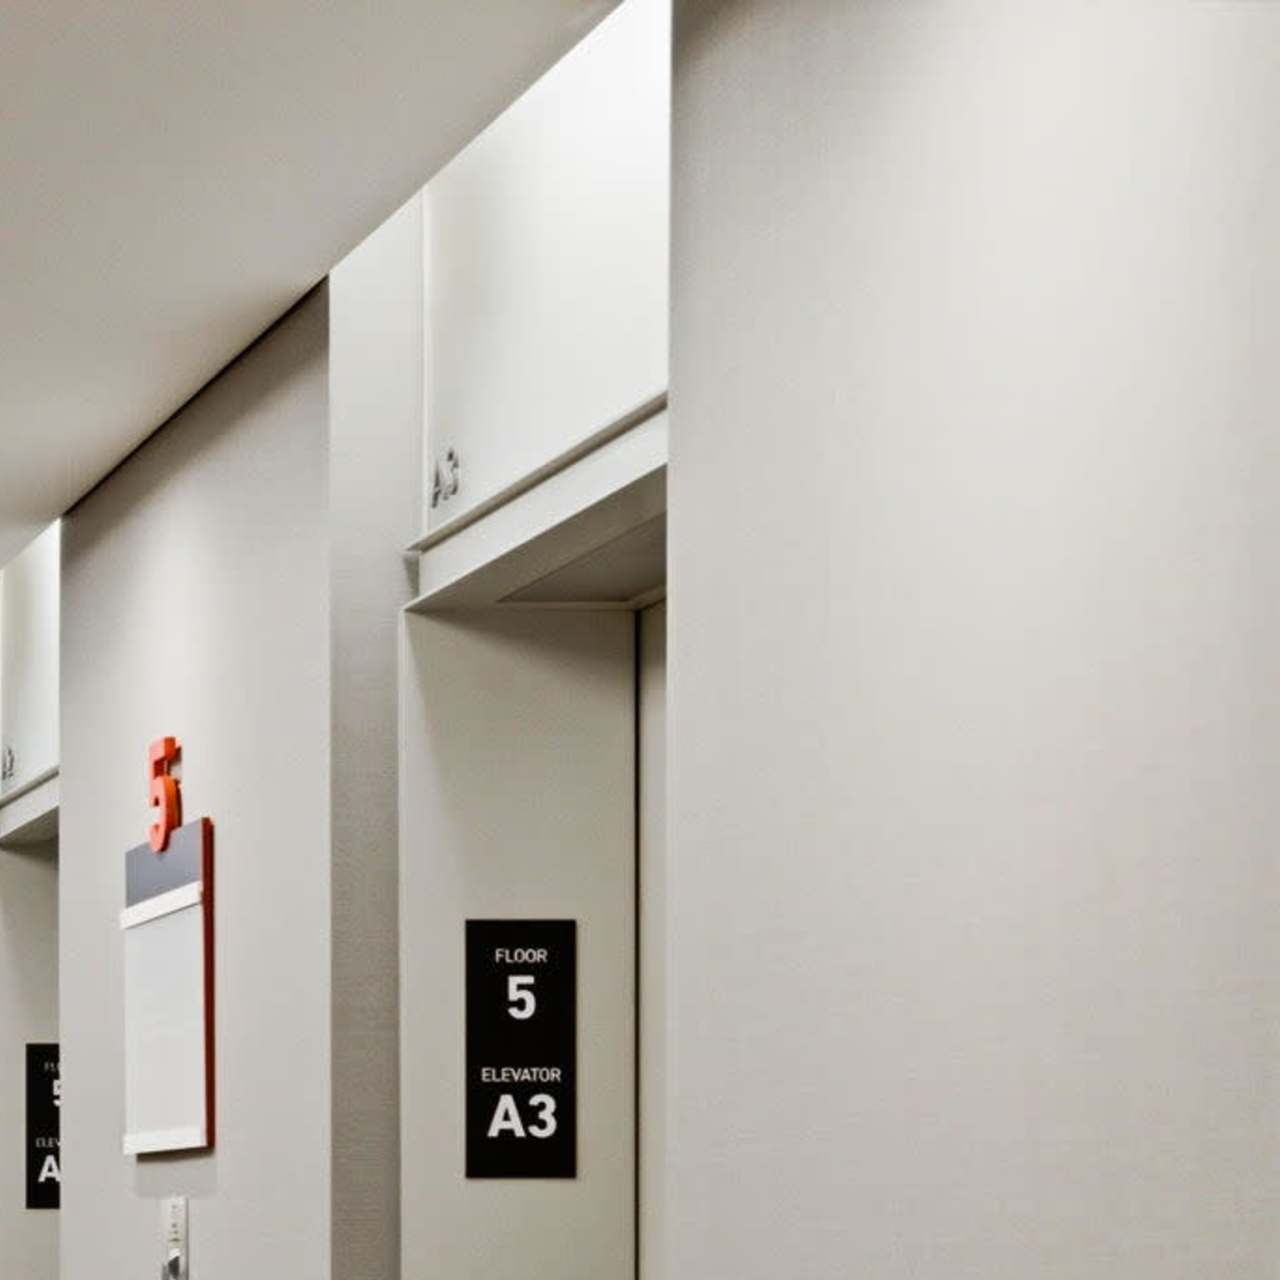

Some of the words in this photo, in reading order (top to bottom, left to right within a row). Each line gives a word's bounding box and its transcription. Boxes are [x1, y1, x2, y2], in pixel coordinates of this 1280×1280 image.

[148, 736, 182, 853] 5
[495, 948, 548, 963] FLOOR
[507, 975, 536, 1020] 5
[481, 1067, 561, 1082] ELEVATOR
[487, 1093, 557, 1138] A3
